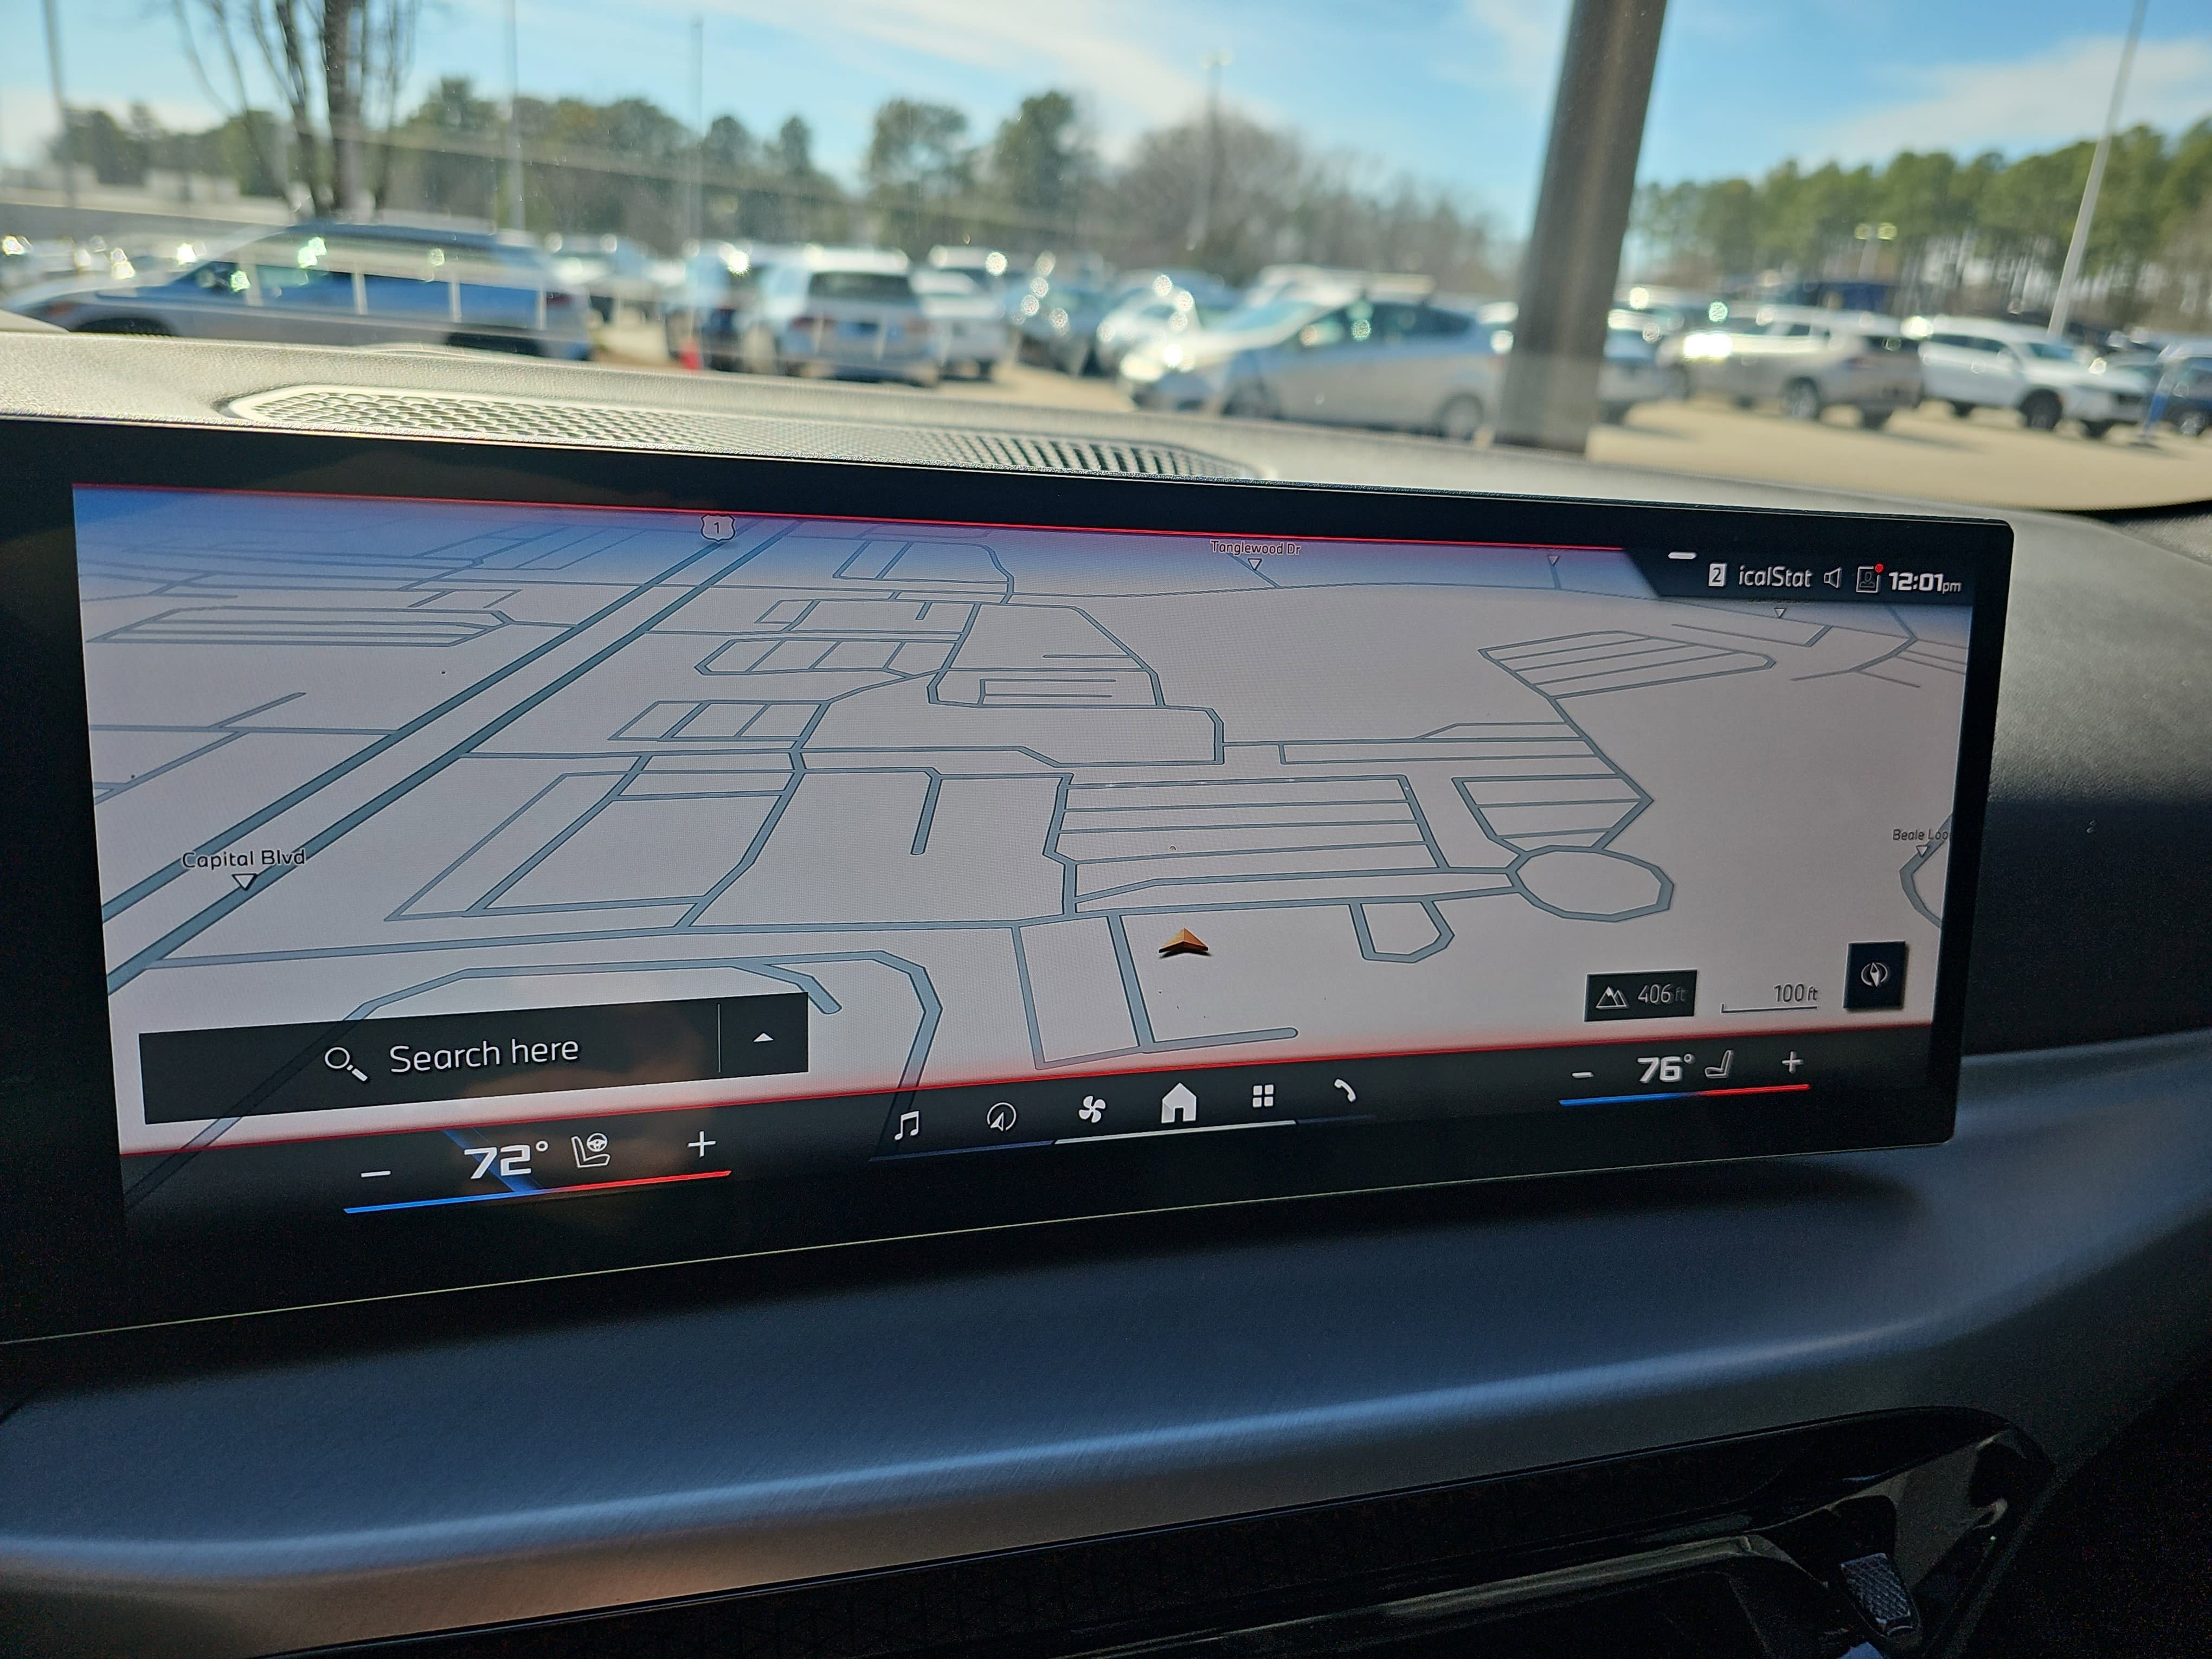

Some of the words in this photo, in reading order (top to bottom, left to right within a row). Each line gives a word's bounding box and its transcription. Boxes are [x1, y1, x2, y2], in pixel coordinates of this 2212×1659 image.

[713, 521, 720, 534] 1
[1211, 541, 1283, 556] Tanglewood
[1287, 543, 1301, 555] Dr
[1712, 567, 1721, 583] 2
[1739, 564, 1814, 588] icalStat
[1892, 828, 1925, 840] Beale
[182, 851, 254, 870] Capital
[261, 849, 305, 865] Blvd
[1637, 984, 1671, 1003] 406
[1774, 983, 1804, 1002] 100
[1807, 986, 1818, 1001] ft
[389, 1040, 500, 1073] Search
[511, 1038, 579, 1064] here
